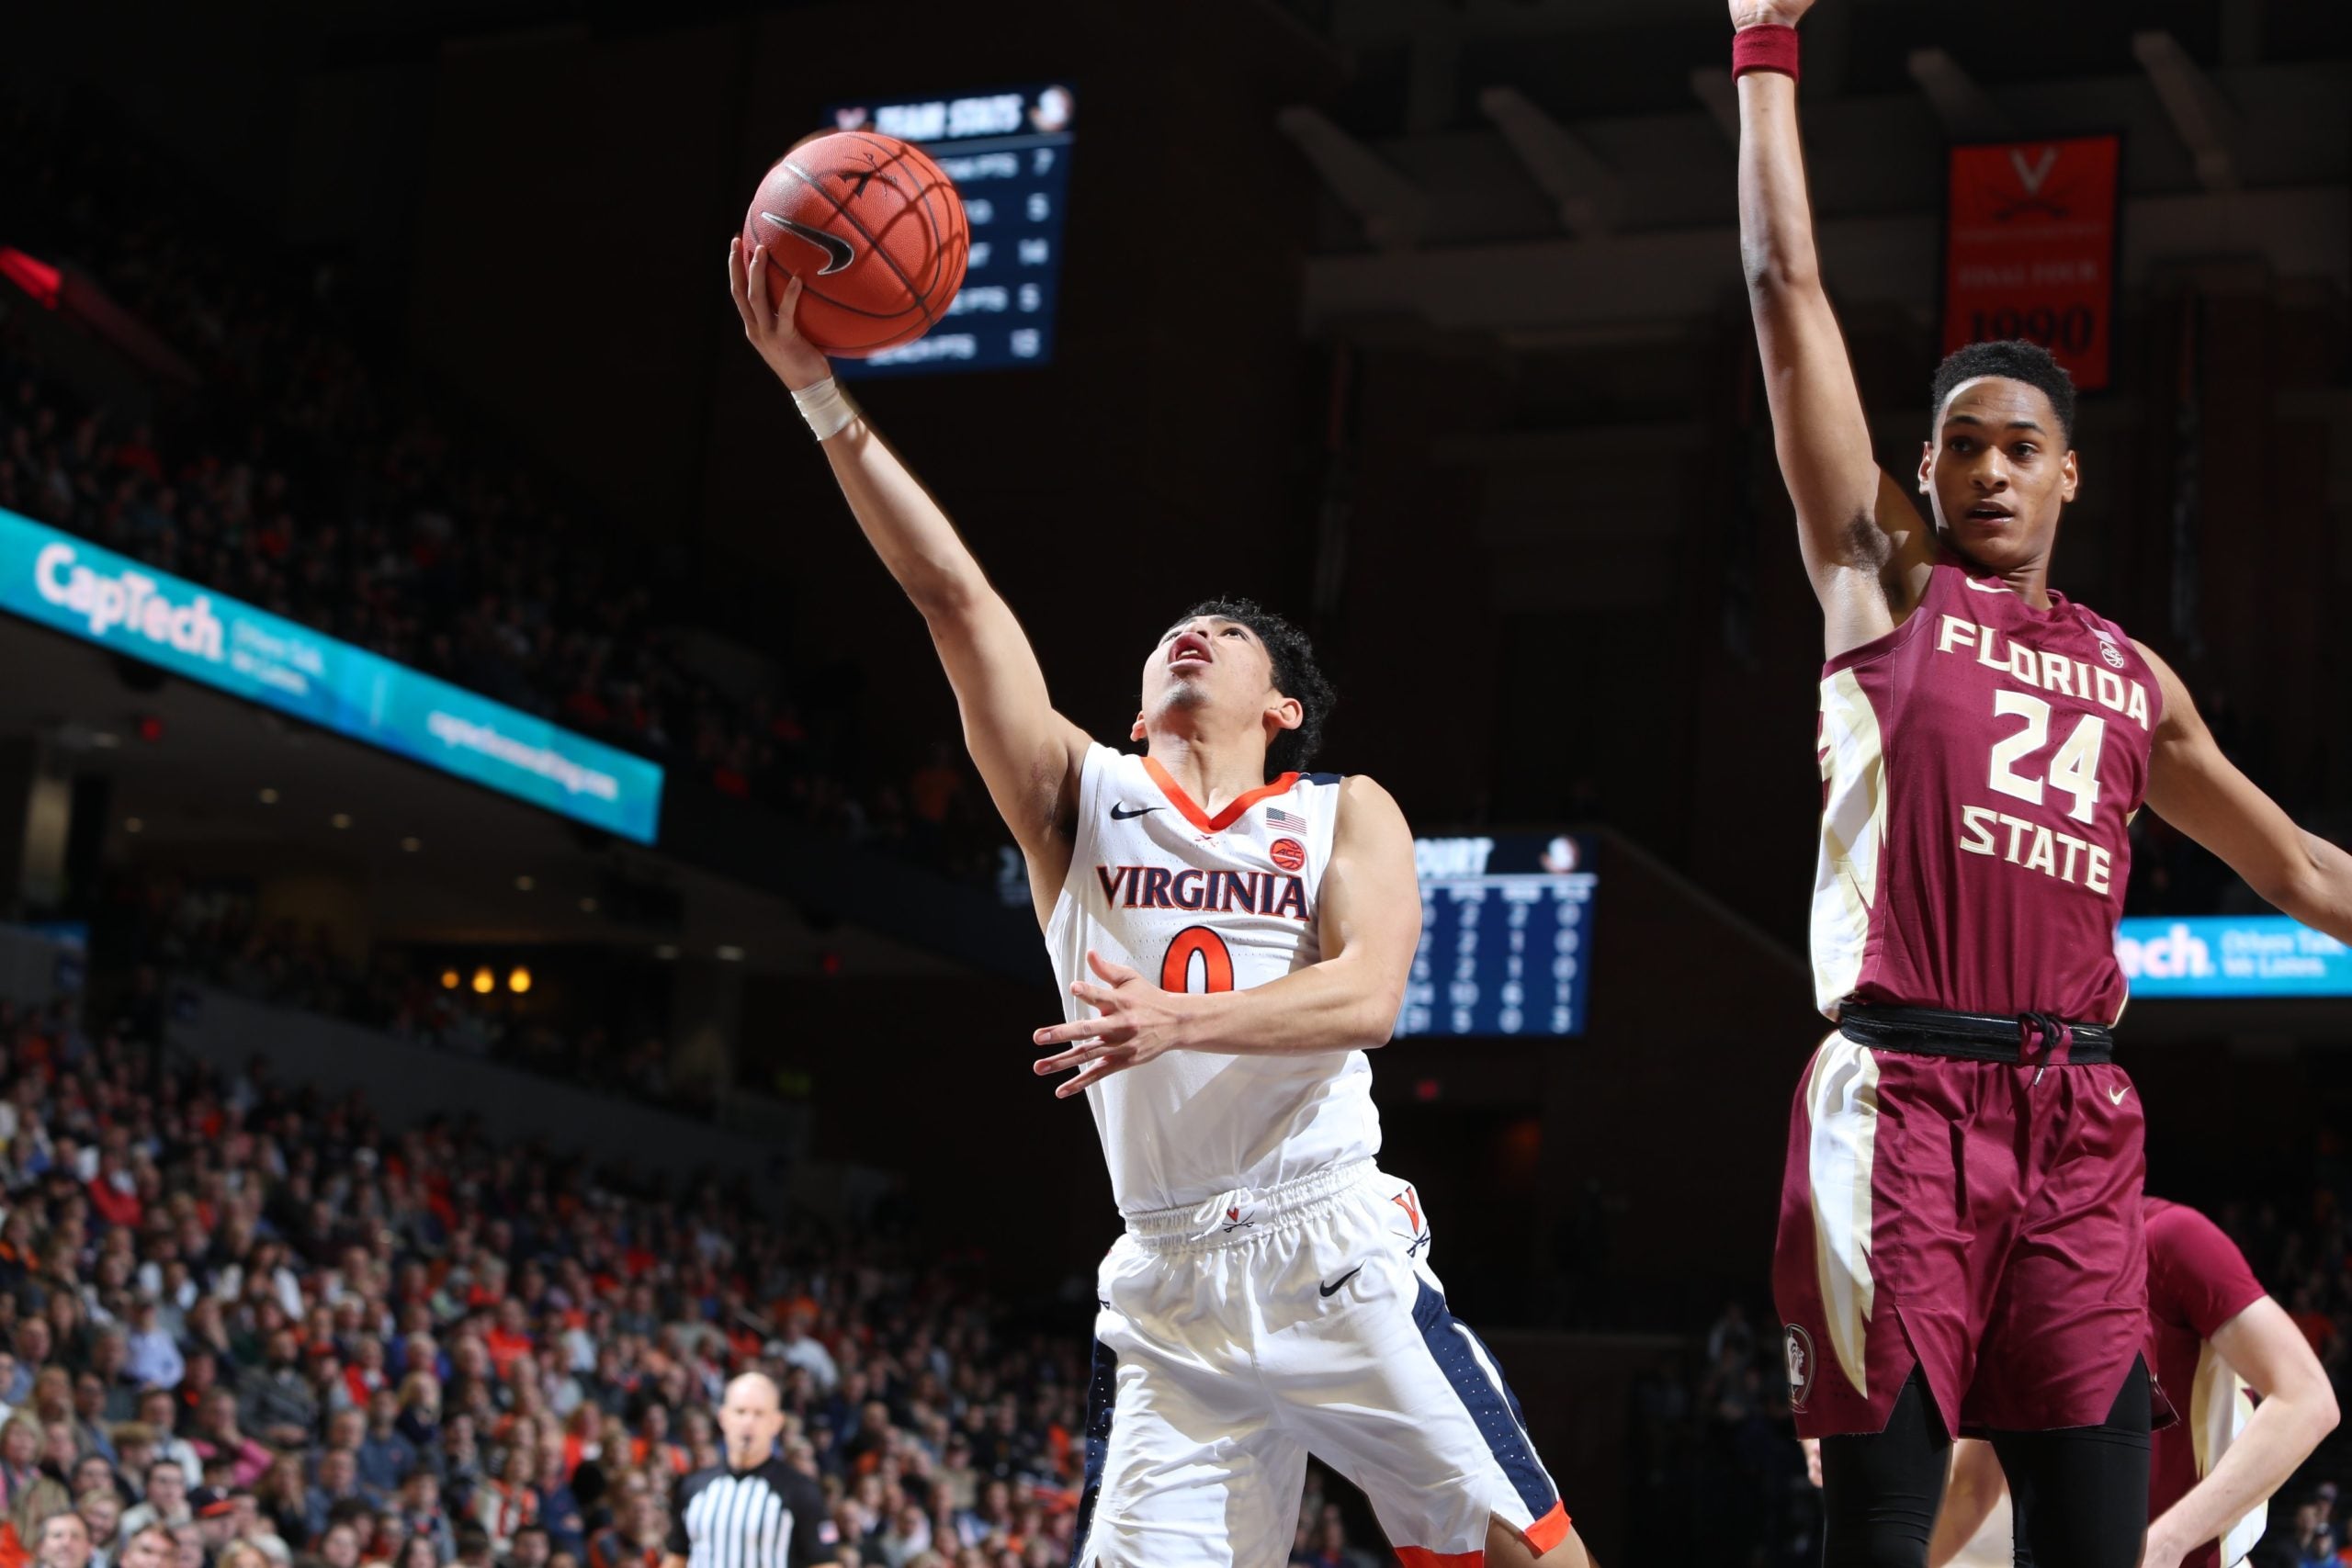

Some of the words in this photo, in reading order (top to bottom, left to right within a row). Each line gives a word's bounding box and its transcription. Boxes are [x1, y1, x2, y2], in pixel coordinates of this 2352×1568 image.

[1937, 615, 2148, 731] FLORIDA
[1988, 689, 2106, 824] 24
[1096, 866, 1310, 921] VIRGINIA
[1959, 805, 2111, 895] STATE
